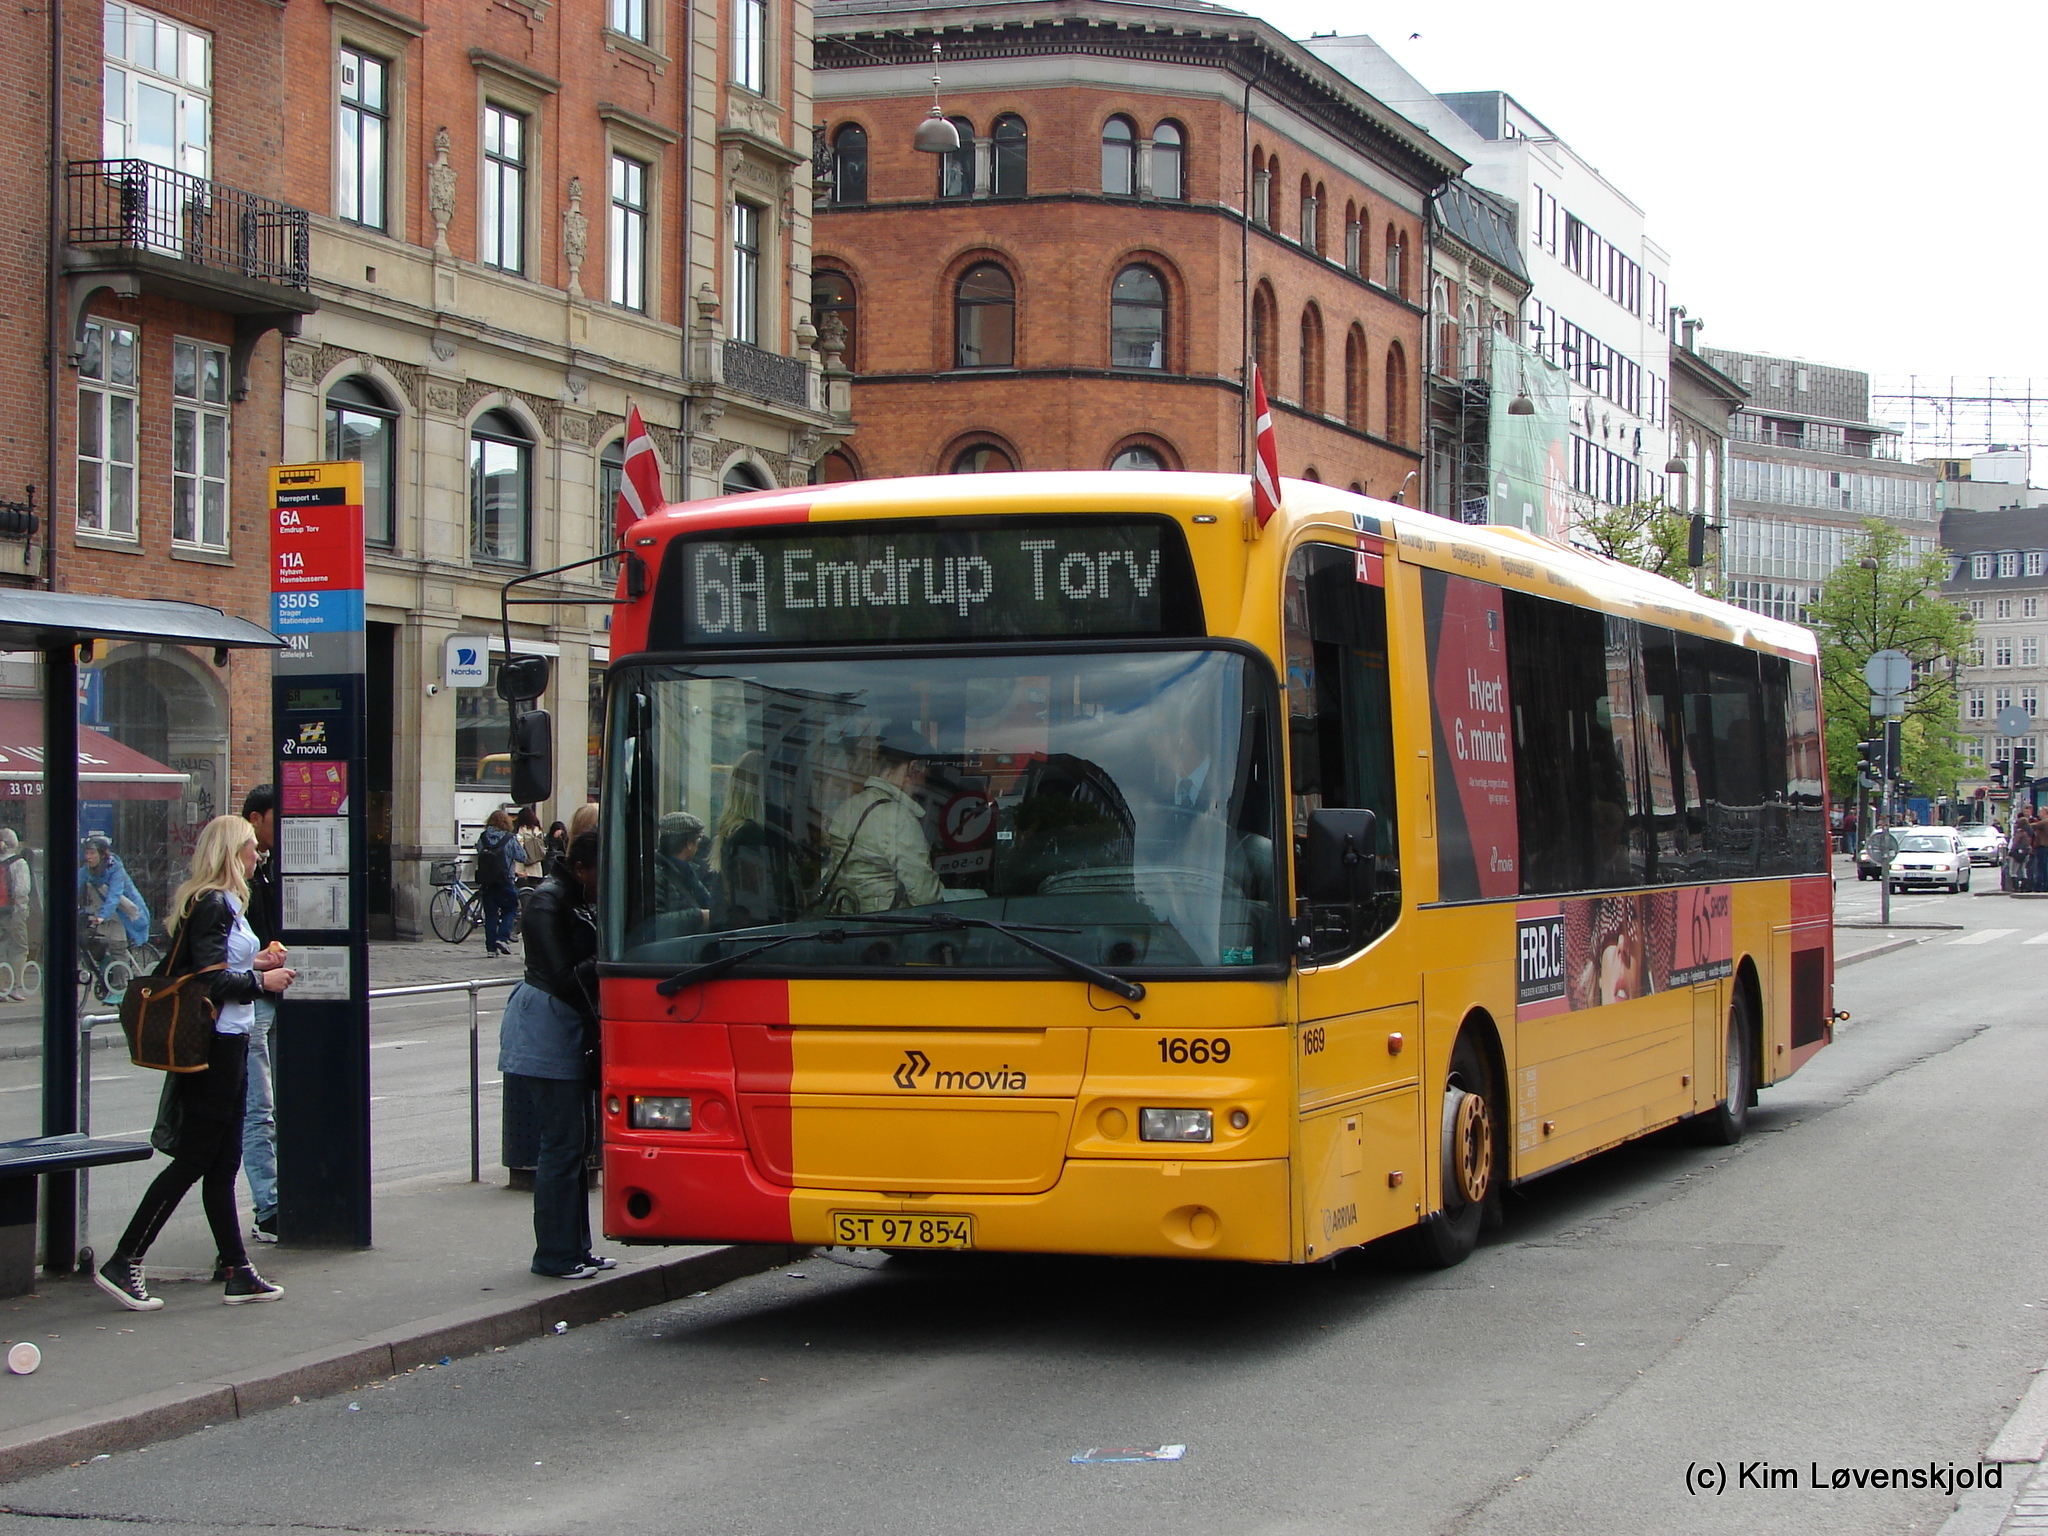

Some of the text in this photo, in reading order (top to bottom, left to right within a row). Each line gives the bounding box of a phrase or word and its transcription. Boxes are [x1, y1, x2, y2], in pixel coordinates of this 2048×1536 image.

[280, 511, 300, 525] 6A
[280, 526, 304, 534] Emdrup
[280, 553, 304, 567] 11A
[696, 540, 1160, 633] 6A Emdrup Torv
[451, 668, 482, 676] Nordea
[1468, 668, 1504, 713] Hvert
[297, 744, 327, 754] movia
[1455, 717, 1507, 763] 6. minut
[10, 783, 20, 794] 33
[23, 783, 33, 794] 12
[1711, 895, 1728, 918] SHOPS
[1692, 887, 1711, 966] 65
[1158, 1037, 1231, 1064] 1669
[1303, 1027, 1325, 1056] 1669
[935, 1064, 1027, 1091] movia
[882, 1219, 914, 1243] 97
[1331, 1202, 1358, 1236] ARRIVA
